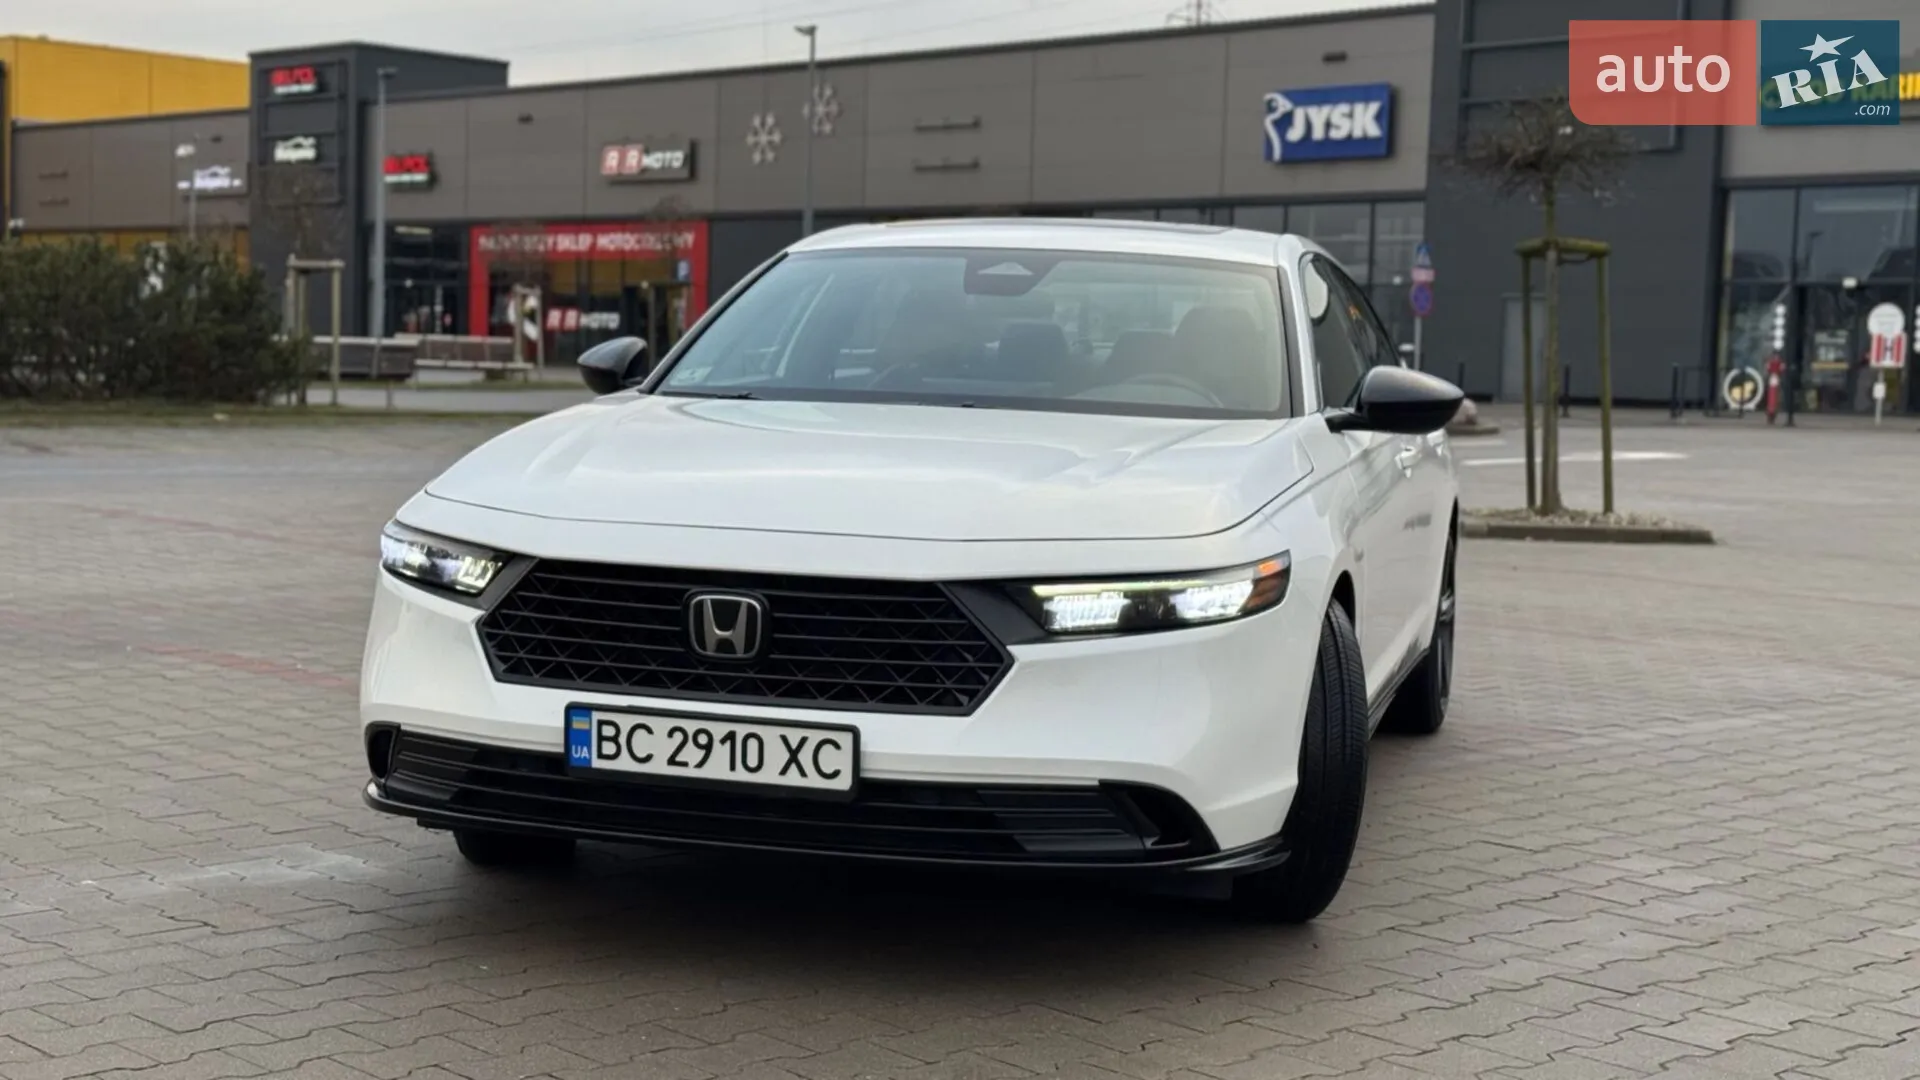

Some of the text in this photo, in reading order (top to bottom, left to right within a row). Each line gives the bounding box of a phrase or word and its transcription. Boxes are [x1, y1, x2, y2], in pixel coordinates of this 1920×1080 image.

[1285, 101, 1383, 143] JYSK
[571, 744, 590, 760] UA
[596, 718, 842, 780] BC 2910 XC
